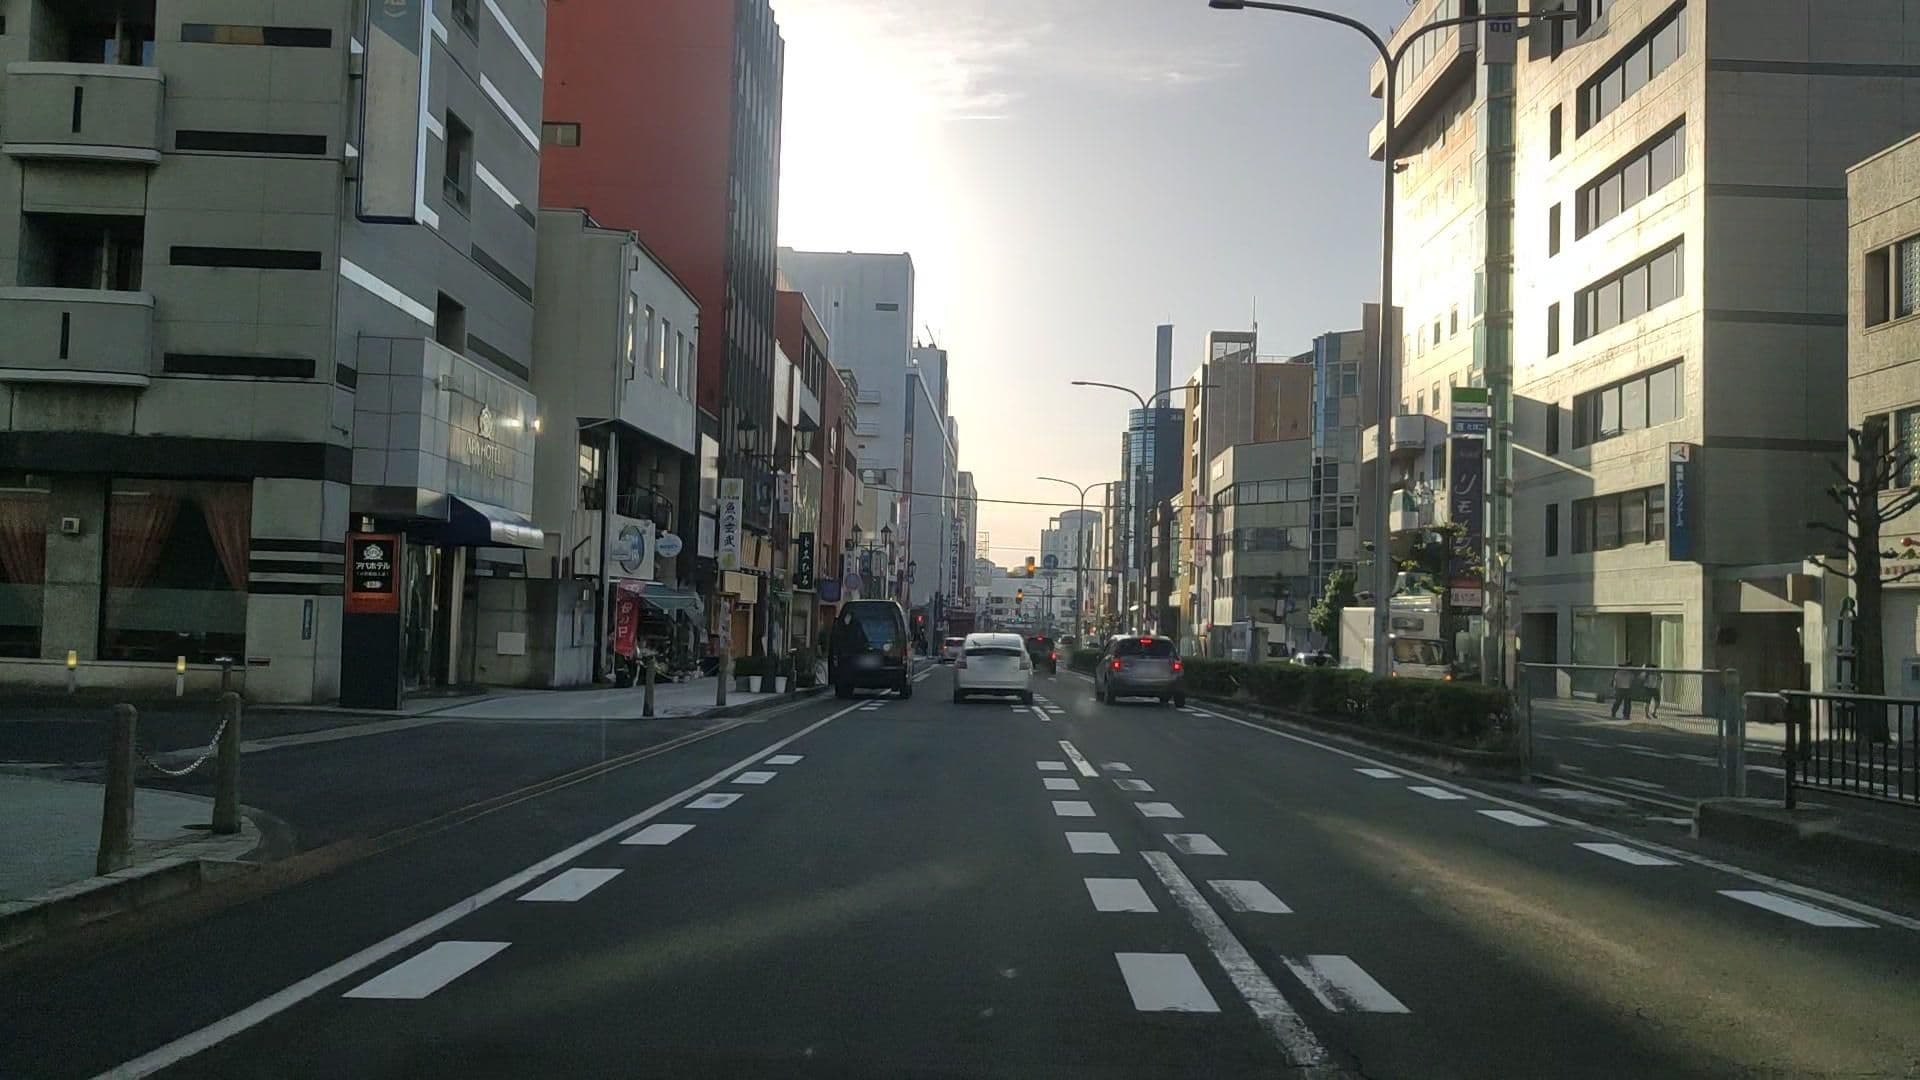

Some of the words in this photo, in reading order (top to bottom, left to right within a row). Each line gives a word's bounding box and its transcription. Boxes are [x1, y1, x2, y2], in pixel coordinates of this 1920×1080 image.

[355, 561, 391, 571] アパホテル
